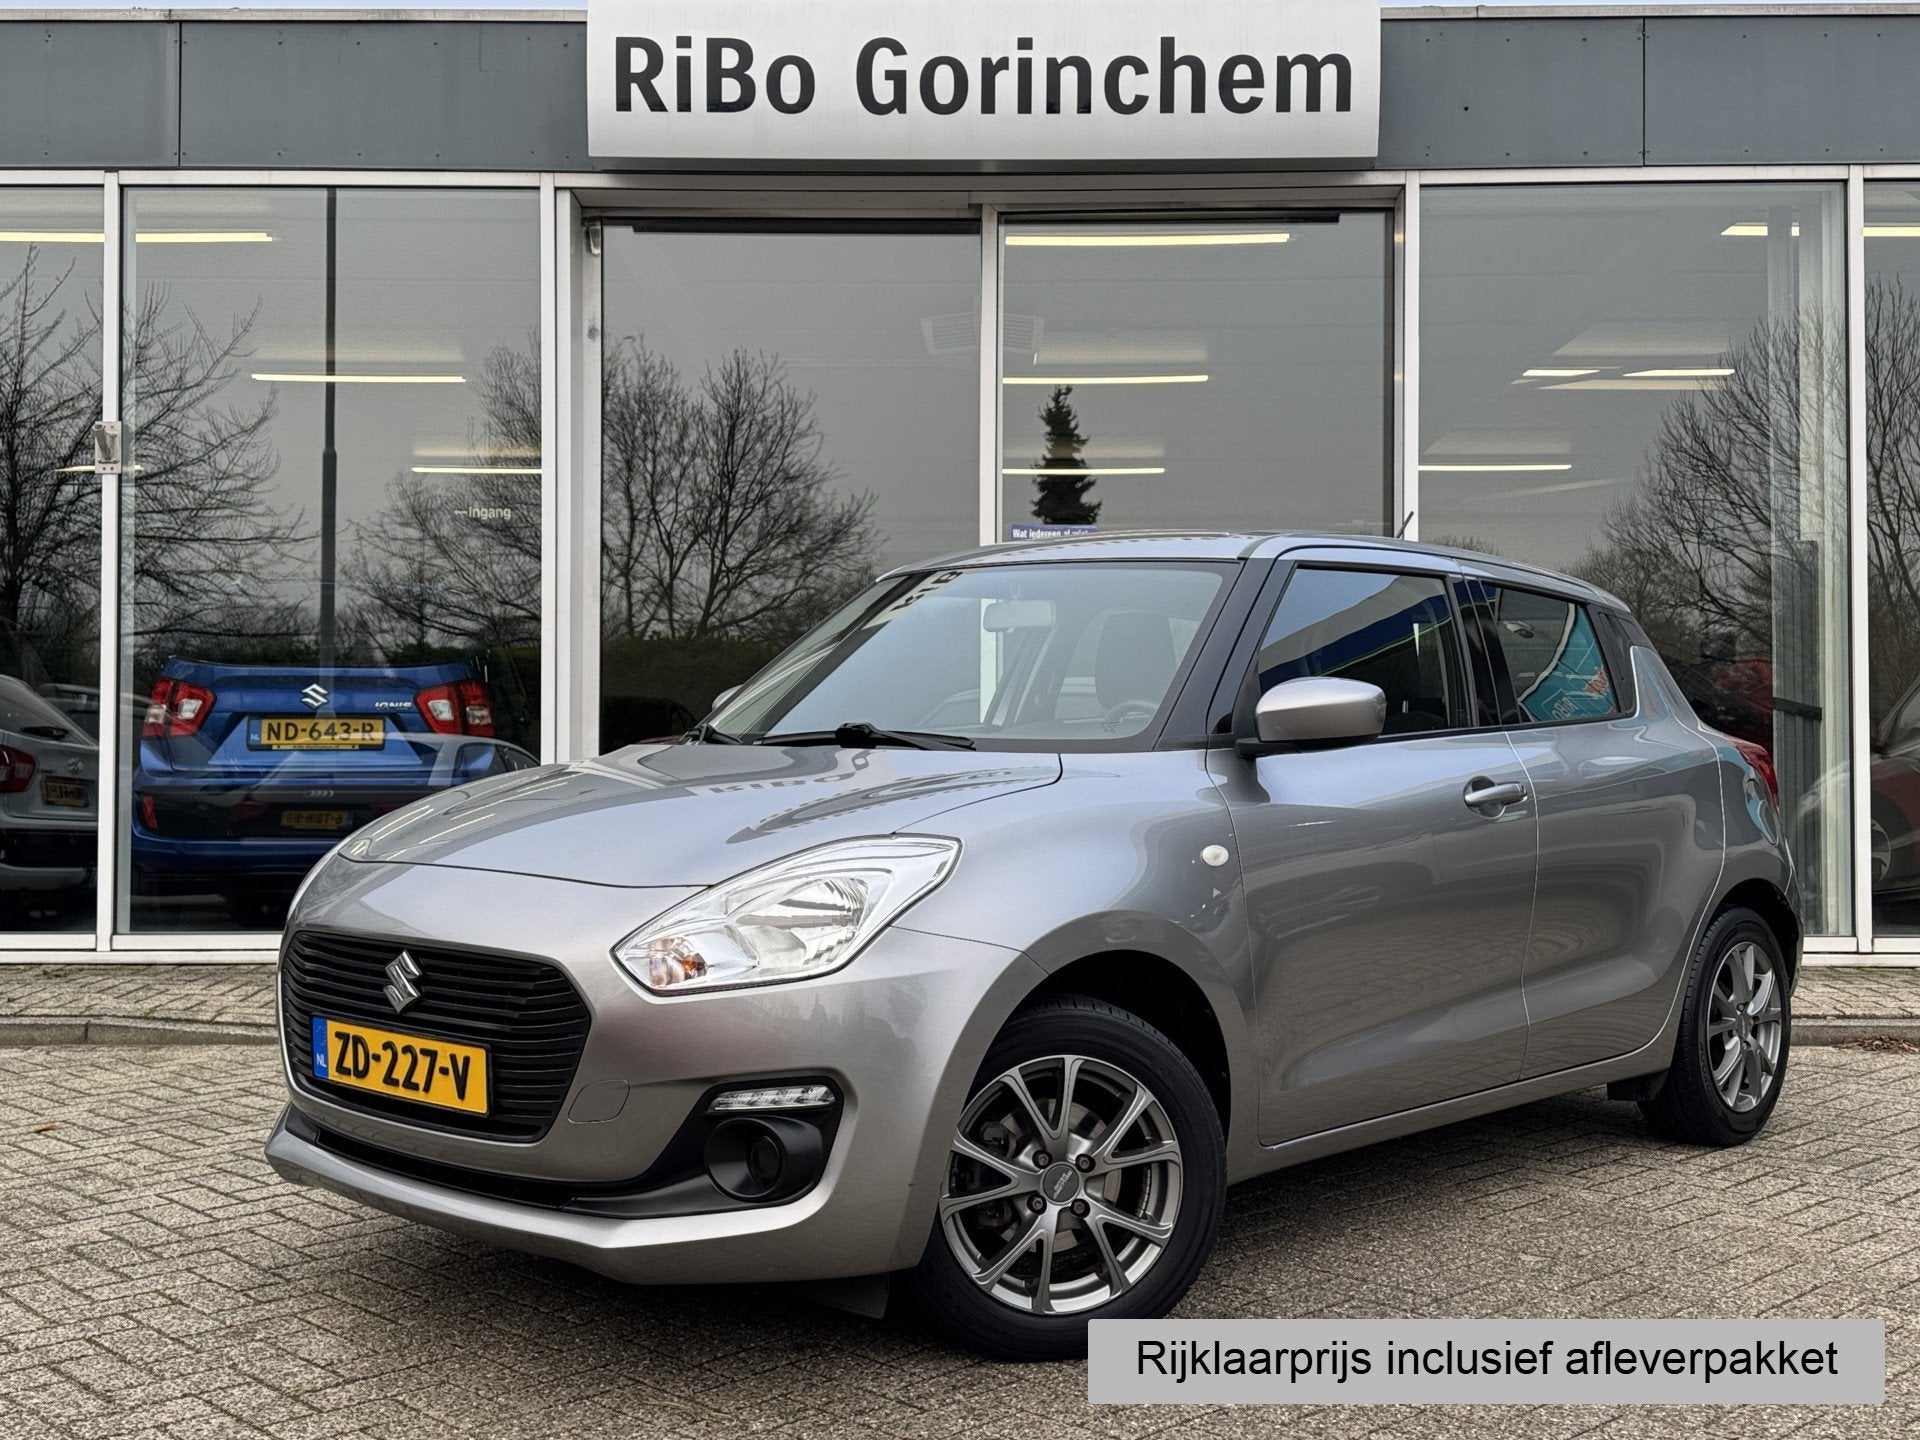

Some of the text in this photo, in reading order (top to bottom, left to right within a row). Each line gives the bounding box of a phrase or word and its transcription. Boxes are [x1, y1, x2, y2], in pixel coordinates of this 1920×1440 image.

[615, 36, 1352, 116] RiBo Gorinchem
[468, 506, 512, 520] Ingang
[1012, 528, 1028, 539] Wat
[266, 722, 375, 742] ND-643-R
[316, 1030, 471, 1101] NL ZD-227-V
